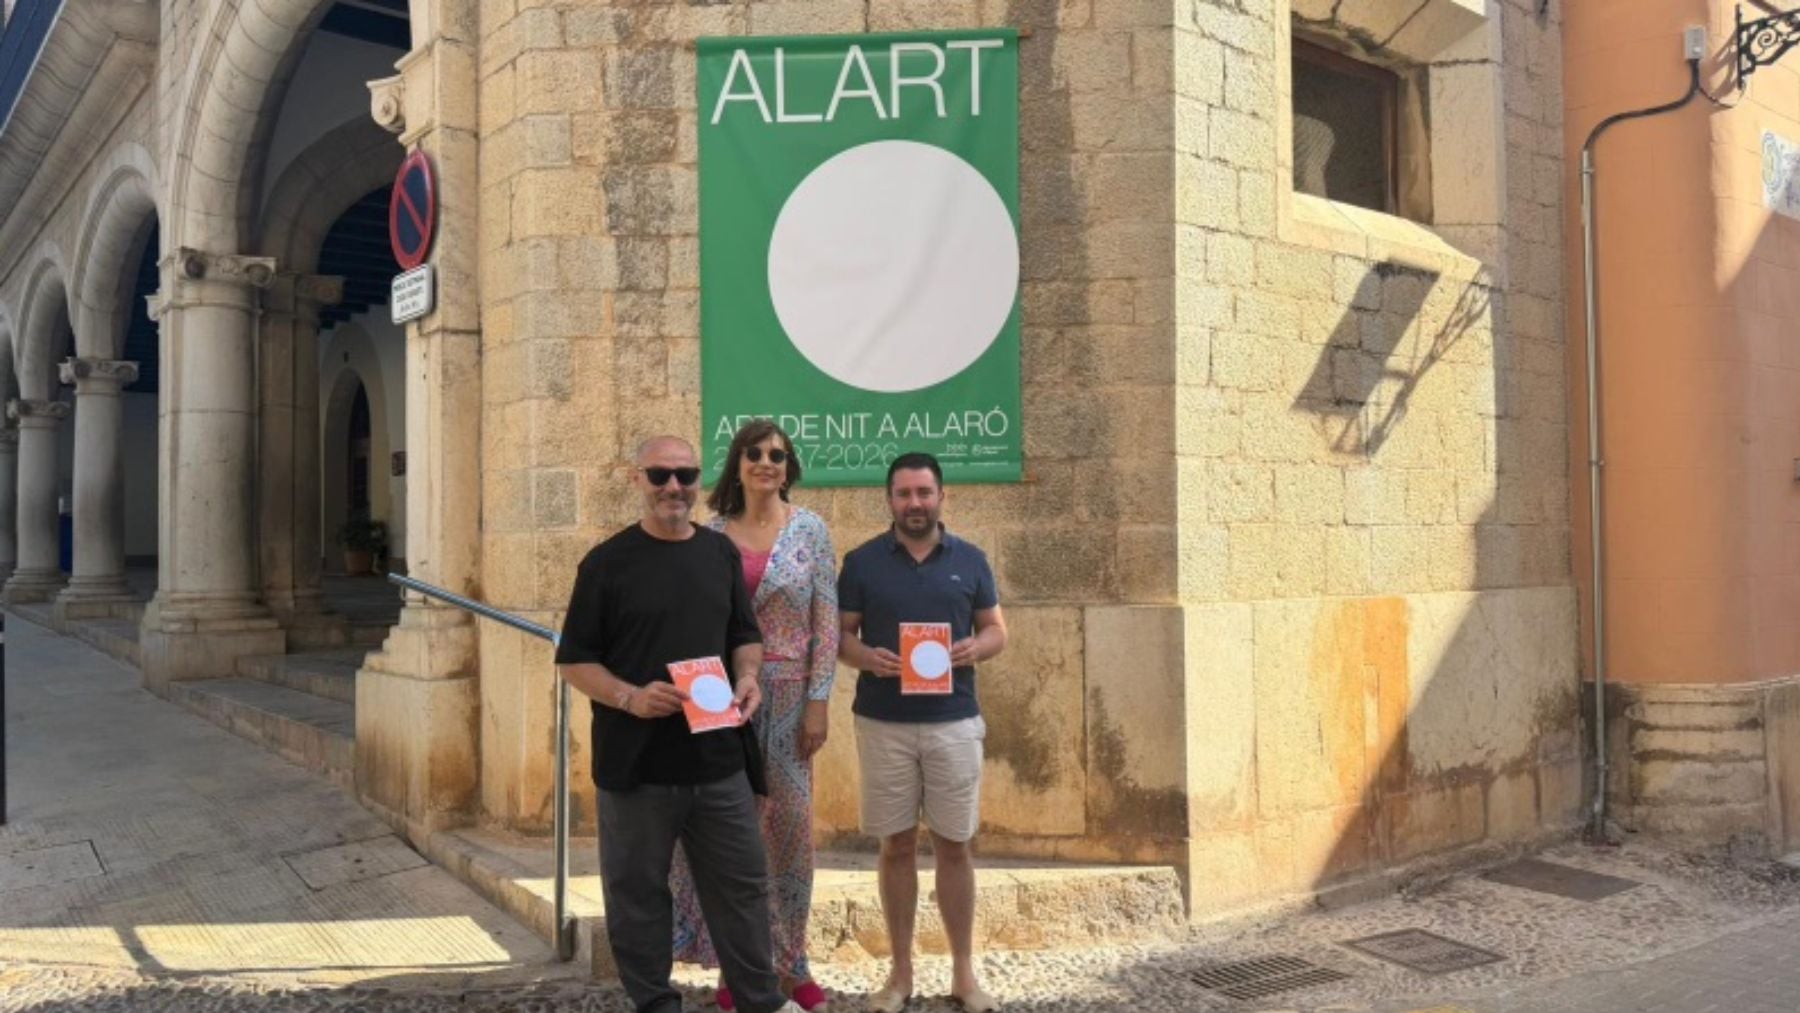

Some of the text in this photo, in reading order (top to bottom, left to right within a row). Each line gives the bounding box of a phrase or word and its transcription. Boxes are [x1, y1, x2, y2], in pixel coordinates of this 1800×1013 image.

[710, 38, 1004, 125] ALART
[778, 414, 820, 440] DE
[826, 412, 872, 440] NIT
[876, 412, 899, 439] A
[903, 404, 1009, 438] ALARÓ
